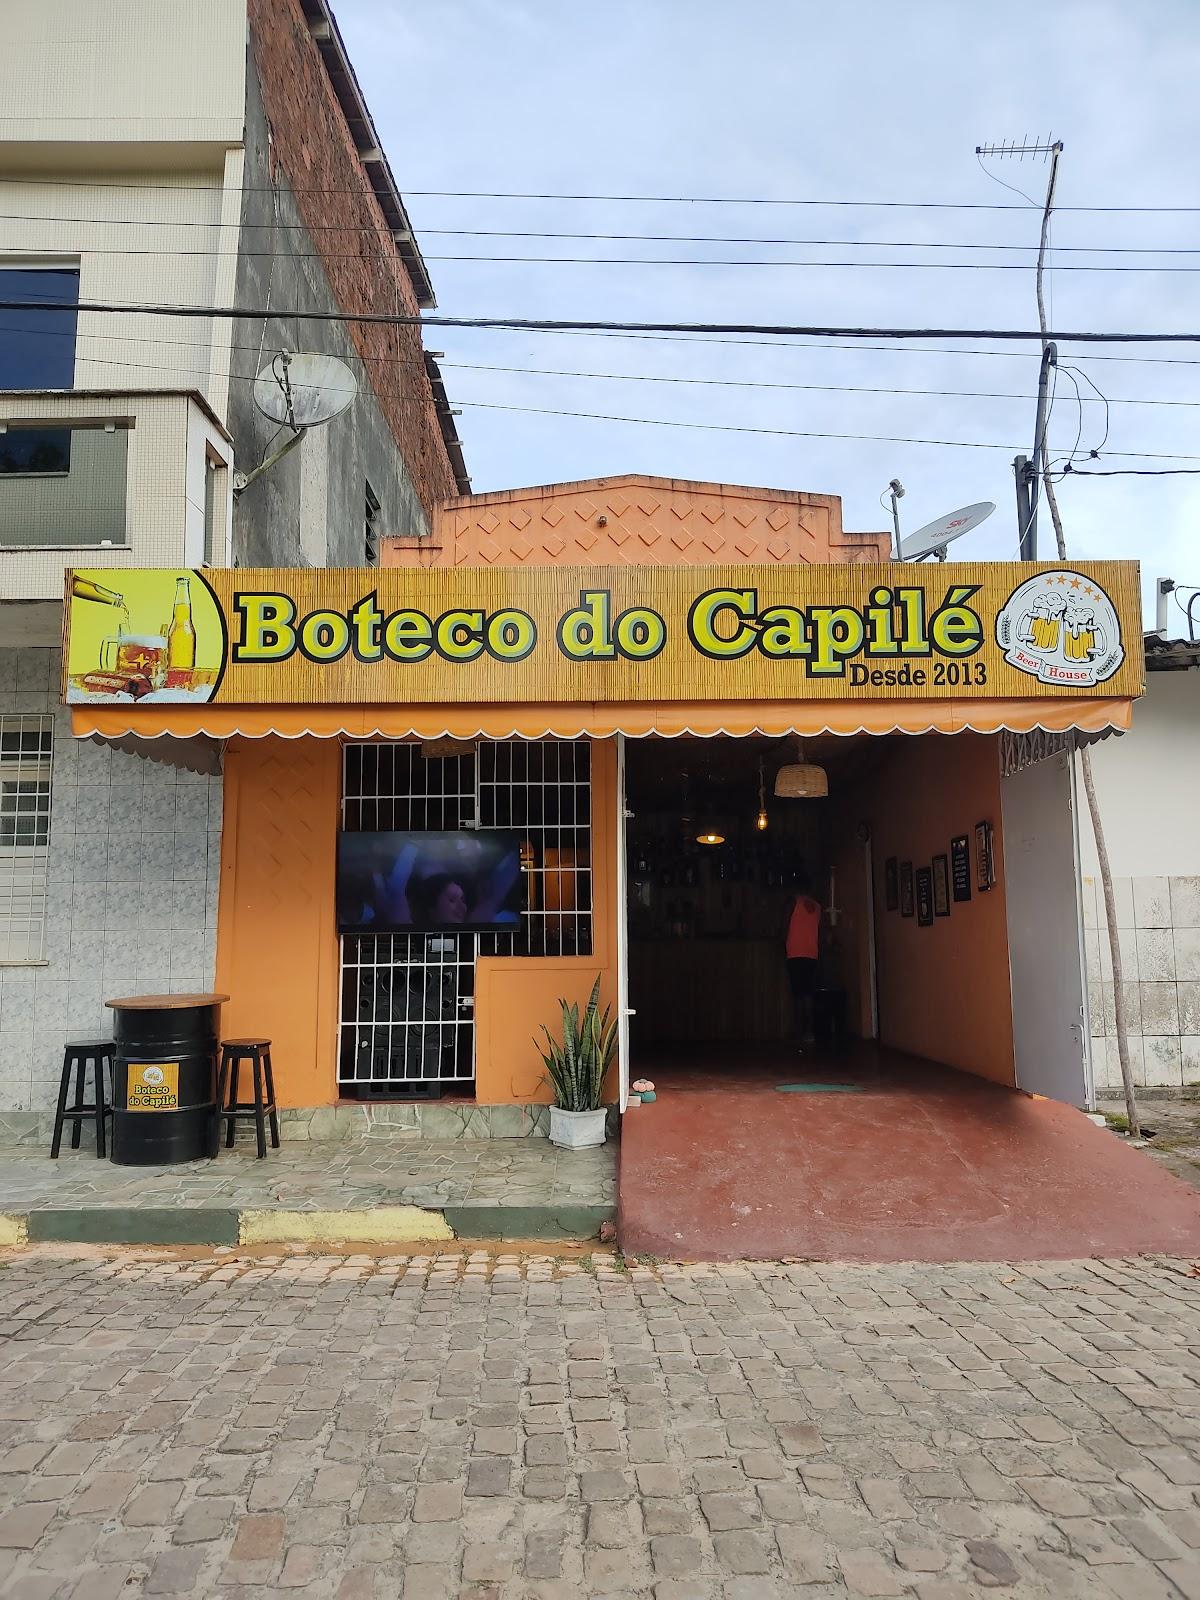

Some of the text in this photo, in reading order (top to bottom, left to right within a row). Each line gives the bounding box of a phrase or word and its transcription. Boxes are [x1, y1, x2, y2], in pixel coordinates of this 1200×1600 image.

[232, 585, 984, 677] Boteco do Capilé
[849, 662, 987, 686] Desde 2013
[1015, 652, 1088, 680] Beer House
[128, 1094, 177, 1108] do Capilé
[134, 1084, 169, 1094] Boteco
